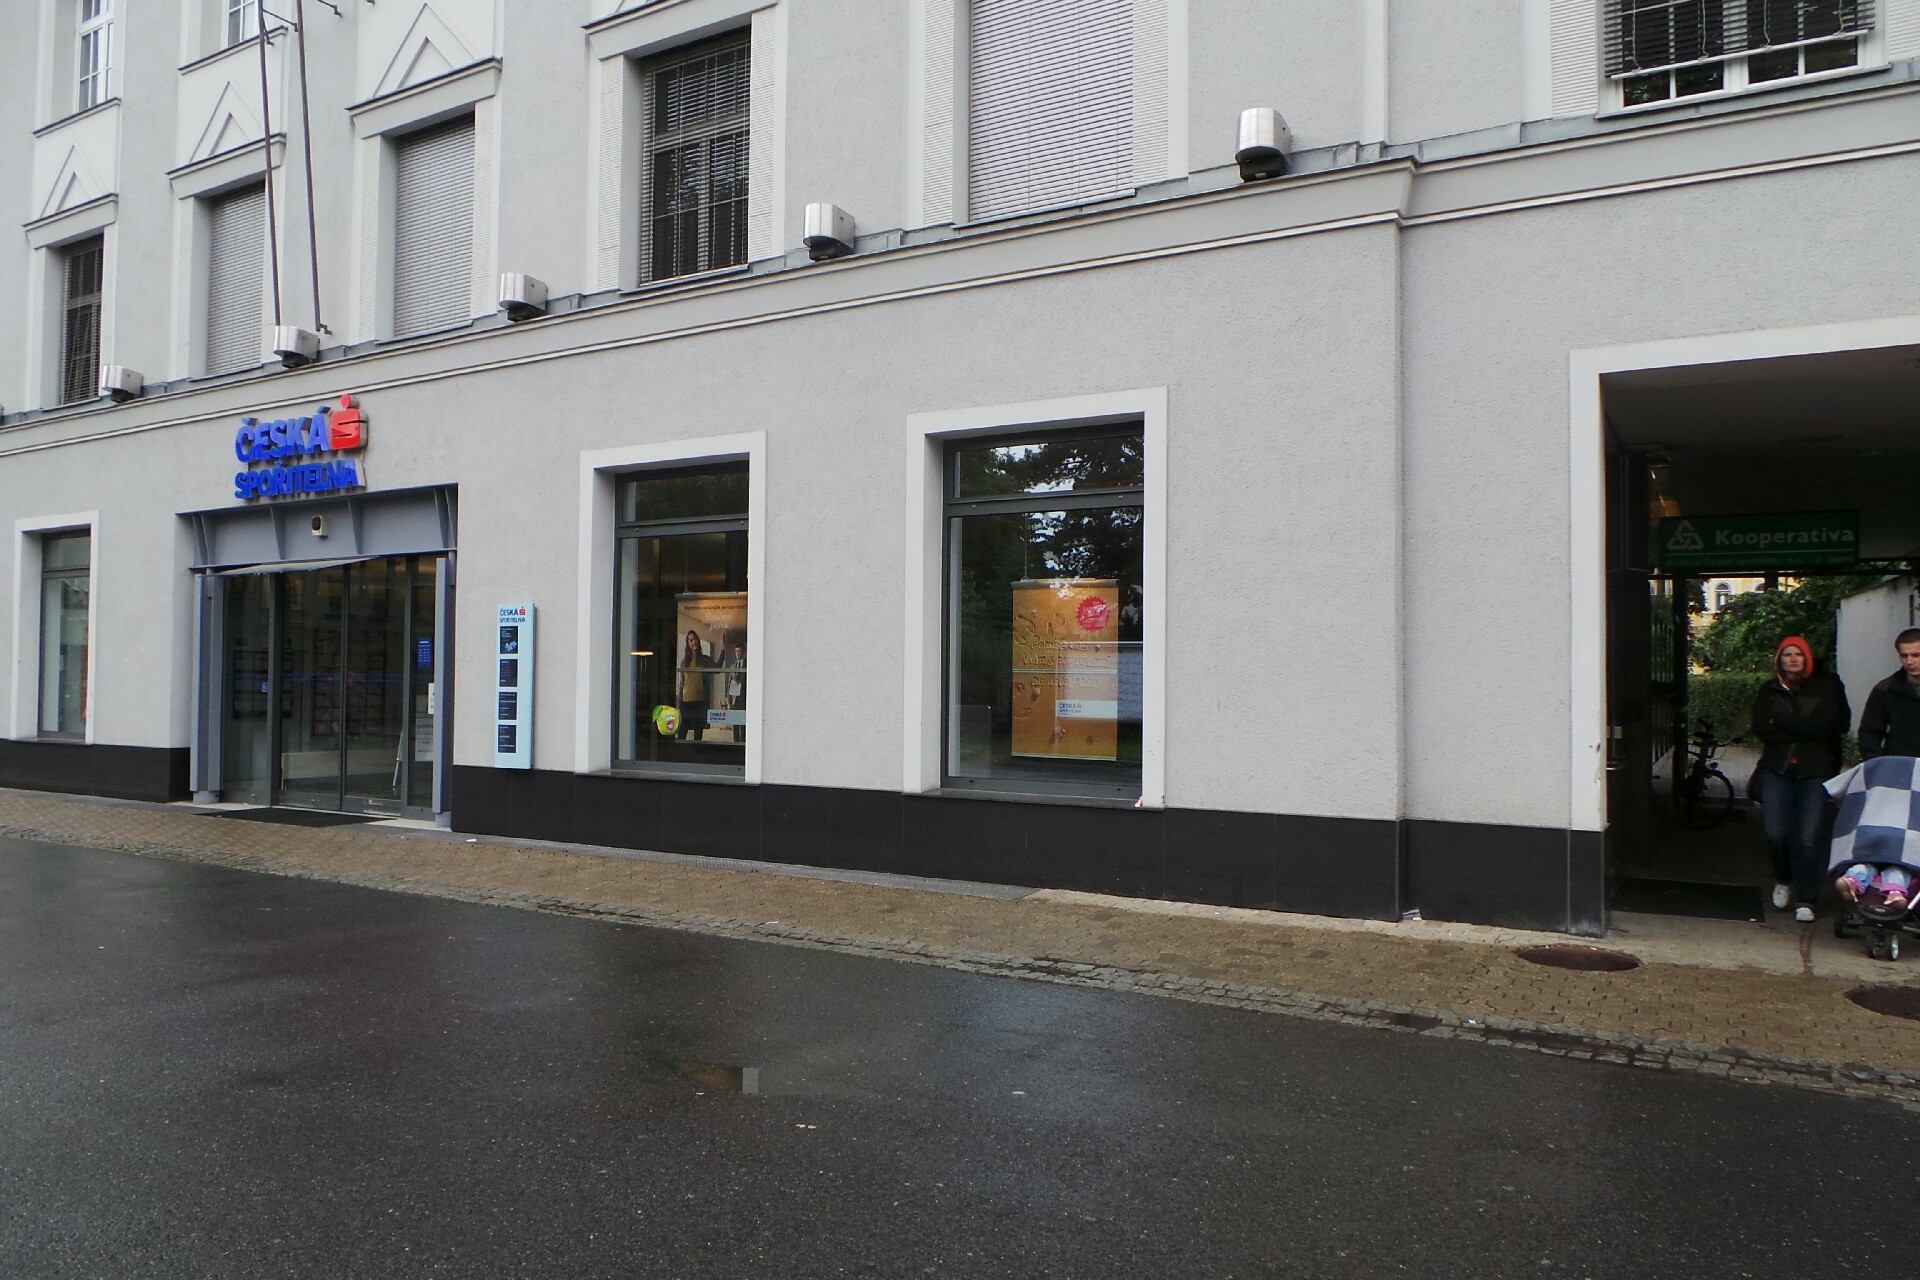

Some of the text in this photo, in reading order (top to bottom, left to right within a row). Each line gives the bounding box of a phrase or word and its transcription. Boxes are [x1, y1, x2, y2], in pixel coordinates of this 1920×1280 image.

[235, 406, 331, 463] ČESKÁ
[234, 459, 361, 500] SPOŘITELNA
[1715, 527, 1855, 548] Kooperativa
